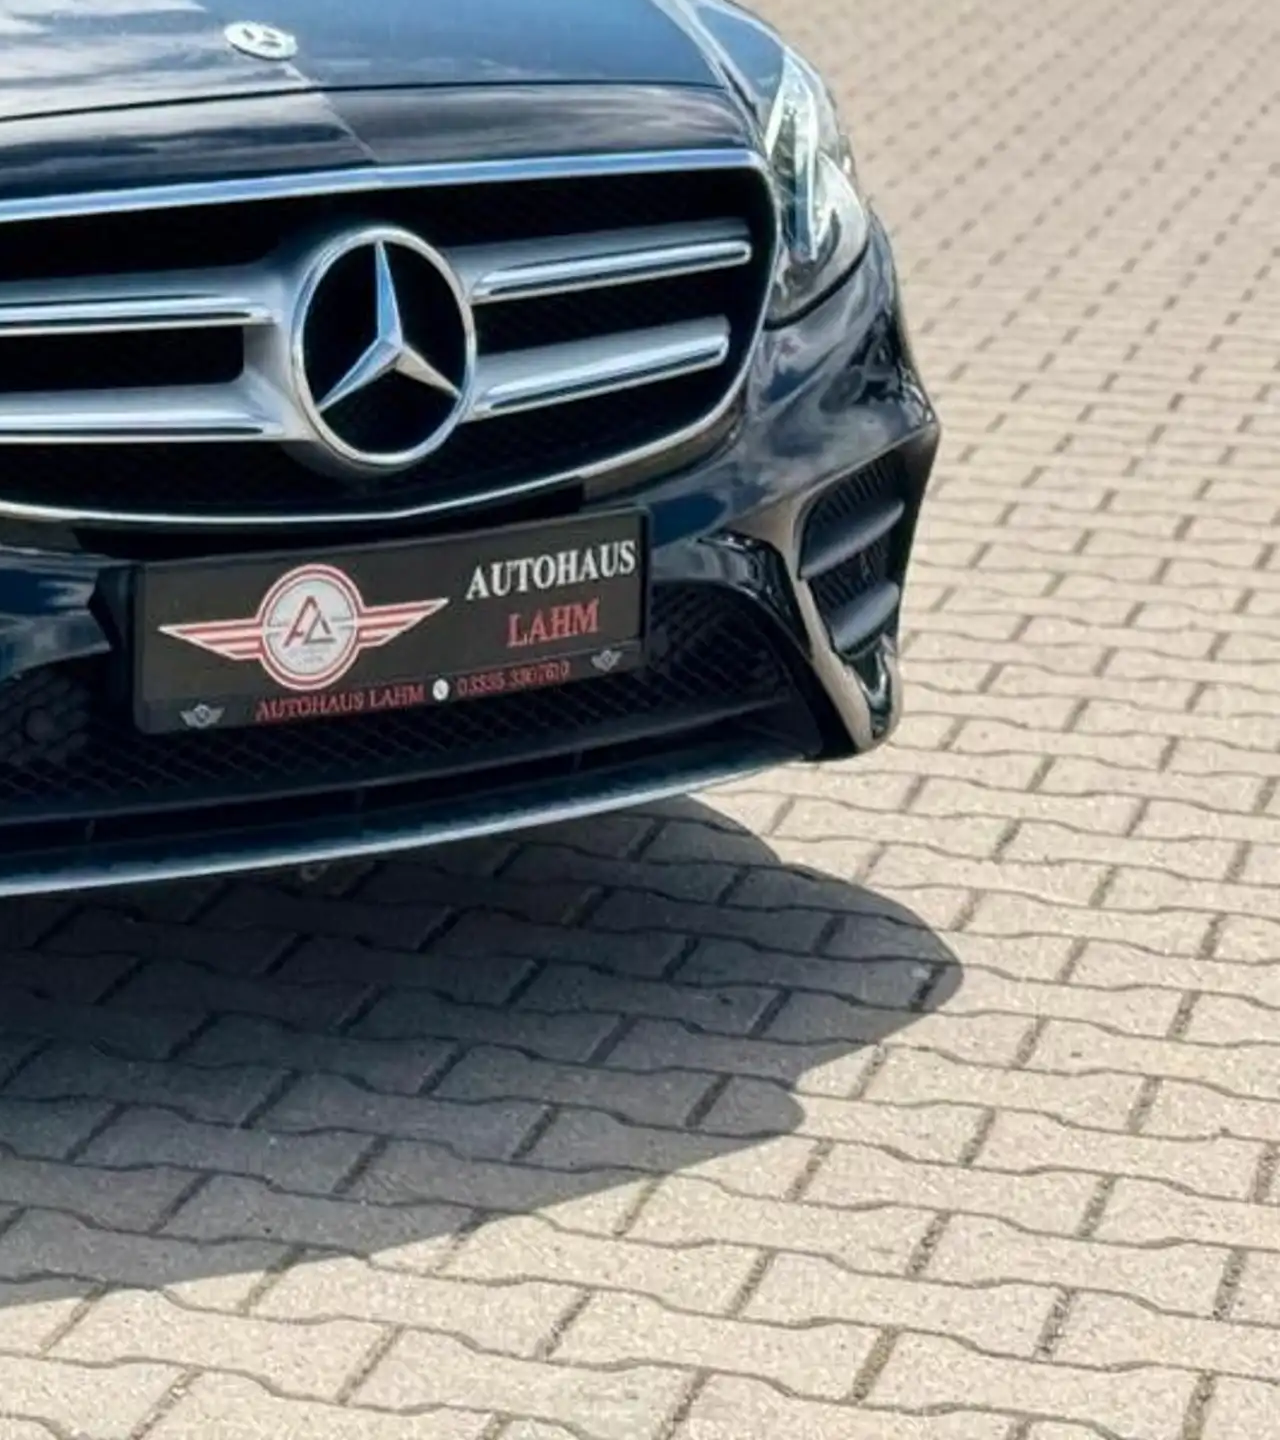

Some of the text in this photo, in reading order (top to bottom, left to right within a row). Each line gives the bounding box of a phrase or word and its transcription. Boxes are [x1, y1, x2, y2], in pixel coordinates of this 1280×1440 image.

[465, 539, 637, 601] AUTOHAUS
[506, 597, 600, 647] LAHM
[254, 692, 364, 723] AUTOHAUS
[369, 682, 426, 708] LAHM
